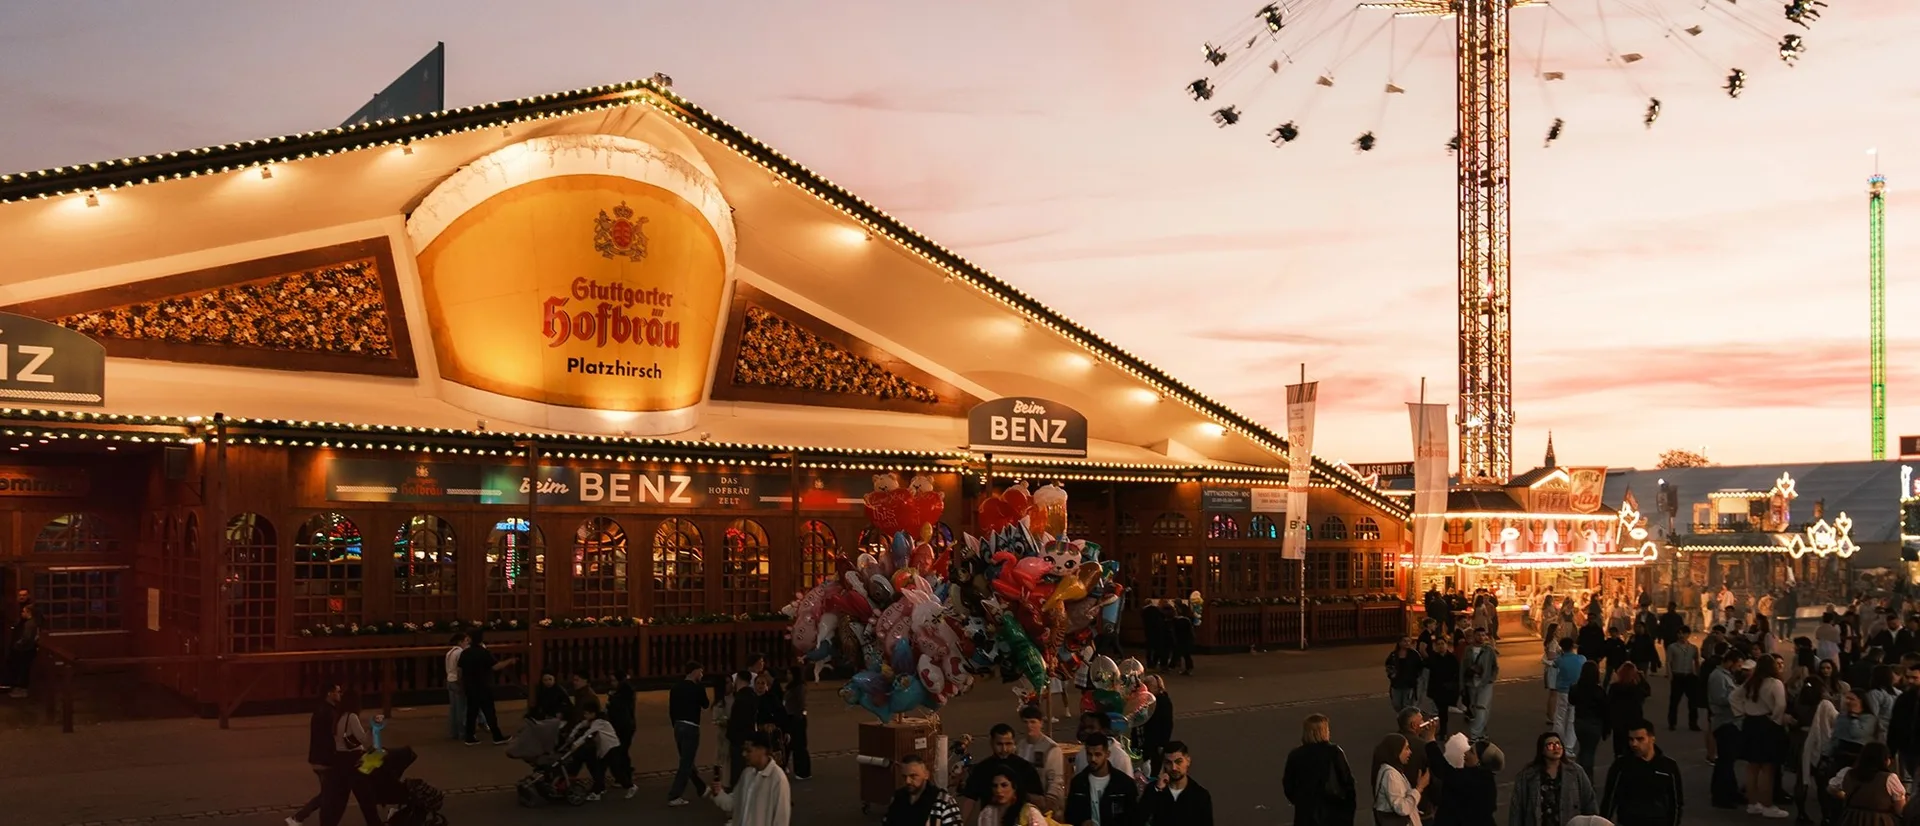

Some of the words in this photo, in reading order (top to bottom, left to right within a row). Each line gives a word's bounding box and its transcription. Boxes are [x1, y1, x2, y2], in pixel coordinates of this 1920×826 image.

[571, 276, 674, 309] Stuttgarter
[542, 295, 680, 349] Hofbräu
[567, 356, 662, 379] Platzhirsch
[1012, 399, 1047, 415] Beim
[990, 415, 1067, 444] BENZ
[519, 477, 569, 495] Beim
[579, 472, 692, 504] BENZ
[708, 485, 750, 496] HOFBRÄU
[720, 476, 738, 485] DAS
[718, 497, 740, 505] ZELT
